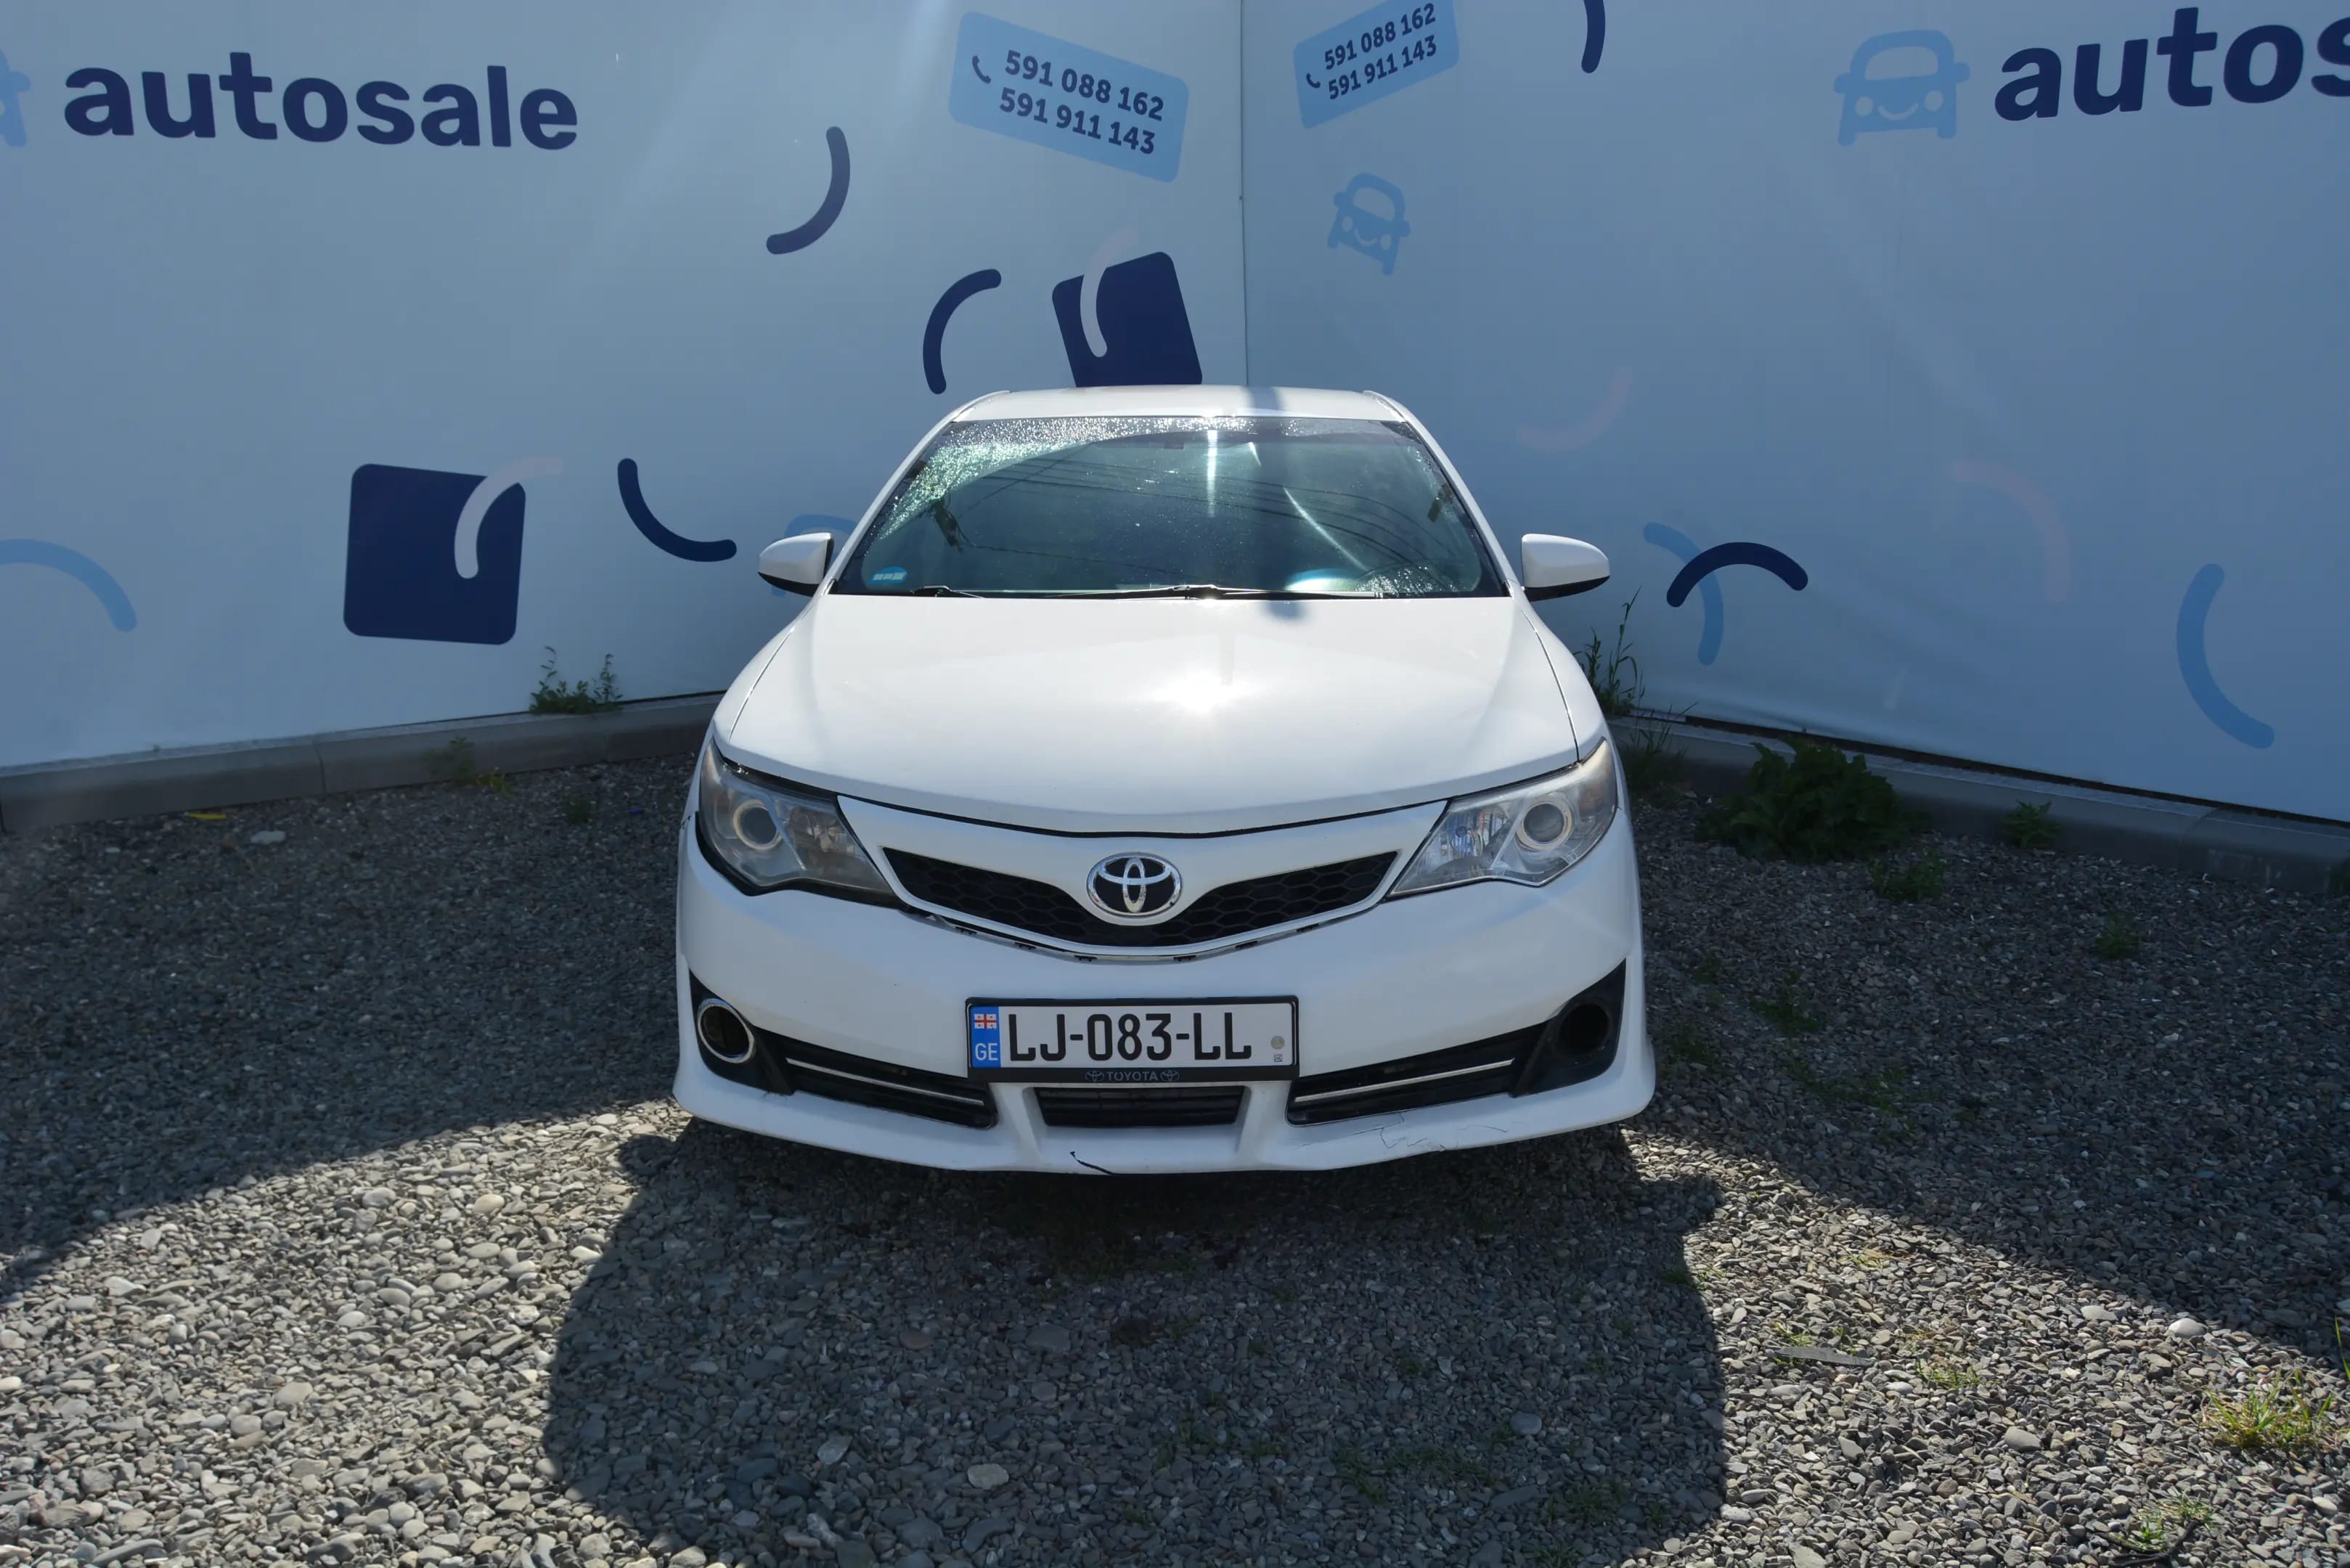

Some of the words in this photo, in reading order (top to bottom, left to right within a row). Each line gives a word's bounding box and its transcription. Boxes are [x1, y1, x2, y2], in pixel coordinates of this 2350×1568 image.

[1325, 40, 1357, 70] 591
[1361, 21, 1396, 52] 088
[1400, 3, 1435, 35] 162
[1329, 70, 1361, 99] 591
[1364, 53, 1398, 83] 911
[1402, 35, 1436, 68] 143
[64, 52, 578, 150] autosale
[1005, 49, 1053, 86] 591
[1061, 68, 1111, 103] 088
[1117, 87, 1163, 121] 162
[1000, 87, 1048, 123] 591
[1056, 105, 1101, 139] 911
[1109, 121, 1155, 154] 143
[974, 1042, 998, 1062] GE
[1008, 1013, 1252, 1062] LJ-083-LL
[1107, 1071, 1159, 1082] TOYOTA
